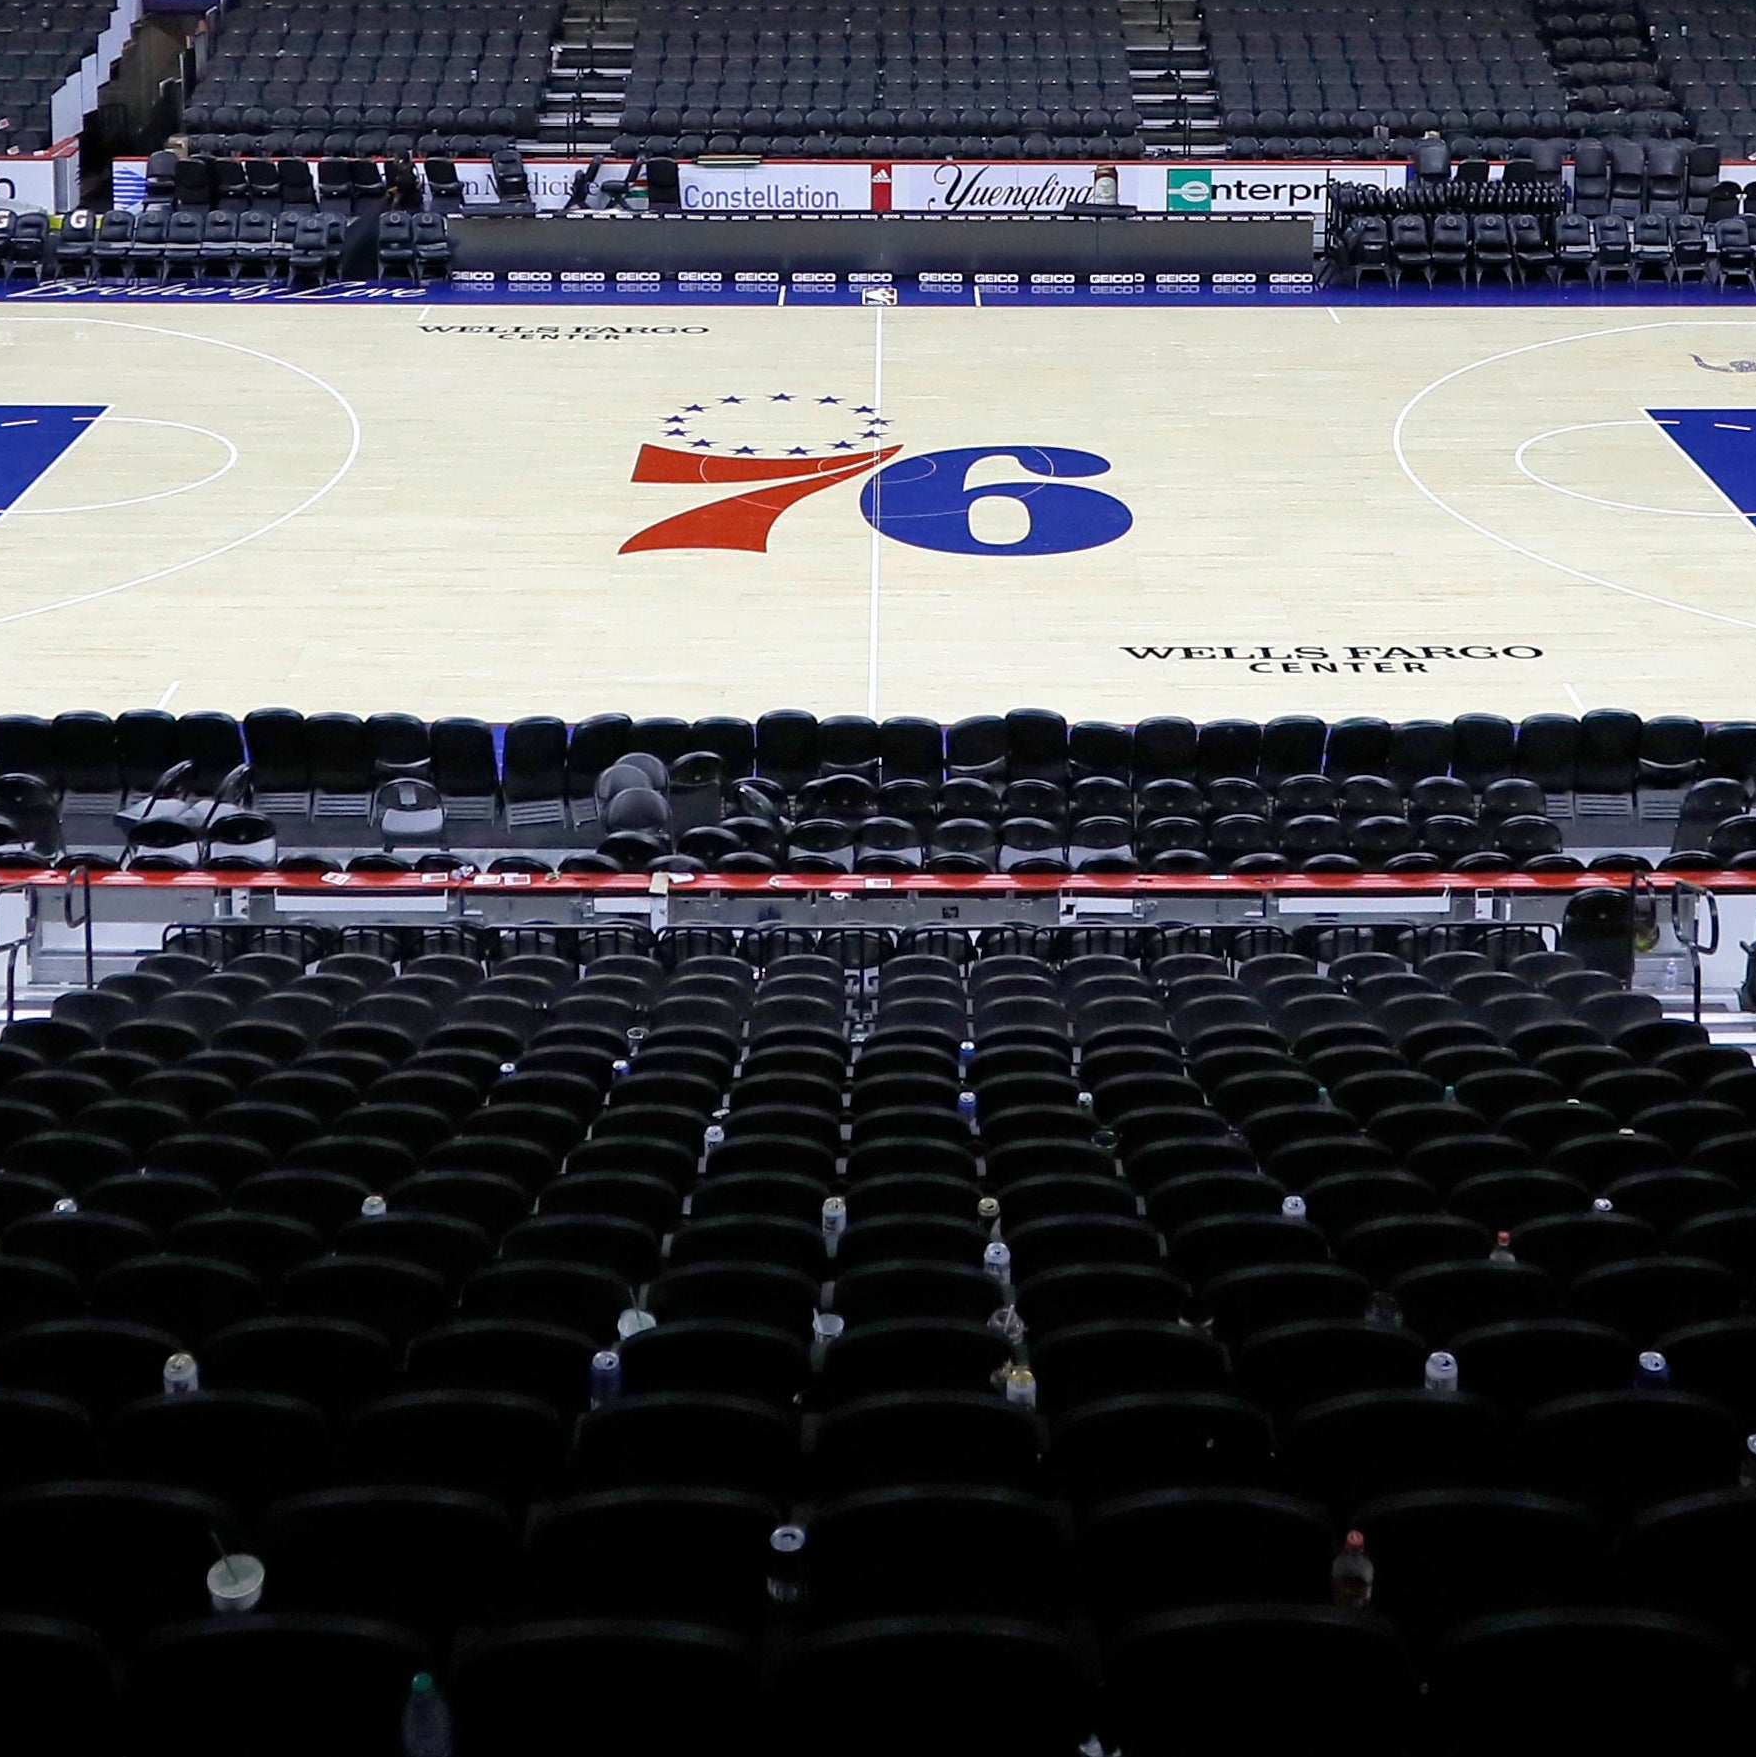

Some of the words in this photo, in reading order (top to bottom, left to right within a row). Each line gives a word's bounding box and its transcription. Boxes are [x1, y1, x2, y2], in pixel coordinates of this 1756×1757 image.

[684, 184, 840, 208] Constellation
[1169, 180, 1379, 206] enterpr
[70, 210, 88, 229] G
[452, 271, 494, 282] GEICO
[507, 271, 551, 282] GEICO
[560, 272, 604, 282] GEICO
[615, 271, 660, 282] GEICO
[677, 272, 721, 282] GEICO
[734, 272, 779, 282] GEICO
[791, 272, 836, 282] GEICO
[848, 272, 892, 282] GEICO
[918, 272, 962, 283] GEICO
[974, 273, 1018, 283] GEICO
[1030, 273, 1074, 283] GEICO
[1089, 273, 1134, 283] GEICO
[1155, 273, 1199, 283] GEICO
[1212, 273, 1256, 283] GEICO
[1269, 273, 1313, 283] GEICO
[5, 280, 289, 300] Brotherly
[273, 280, 429, 300] Love
[417, 325, 561, 335] WELLS
[569, 325, 710, 335] FARGO
[617, 443, 1133, 555] 76
[1119, 646, 1329, 660] WELLS
[1343, 646, 1544, 660] FARGO
[1248, 662, 1429, 674] CENTER
